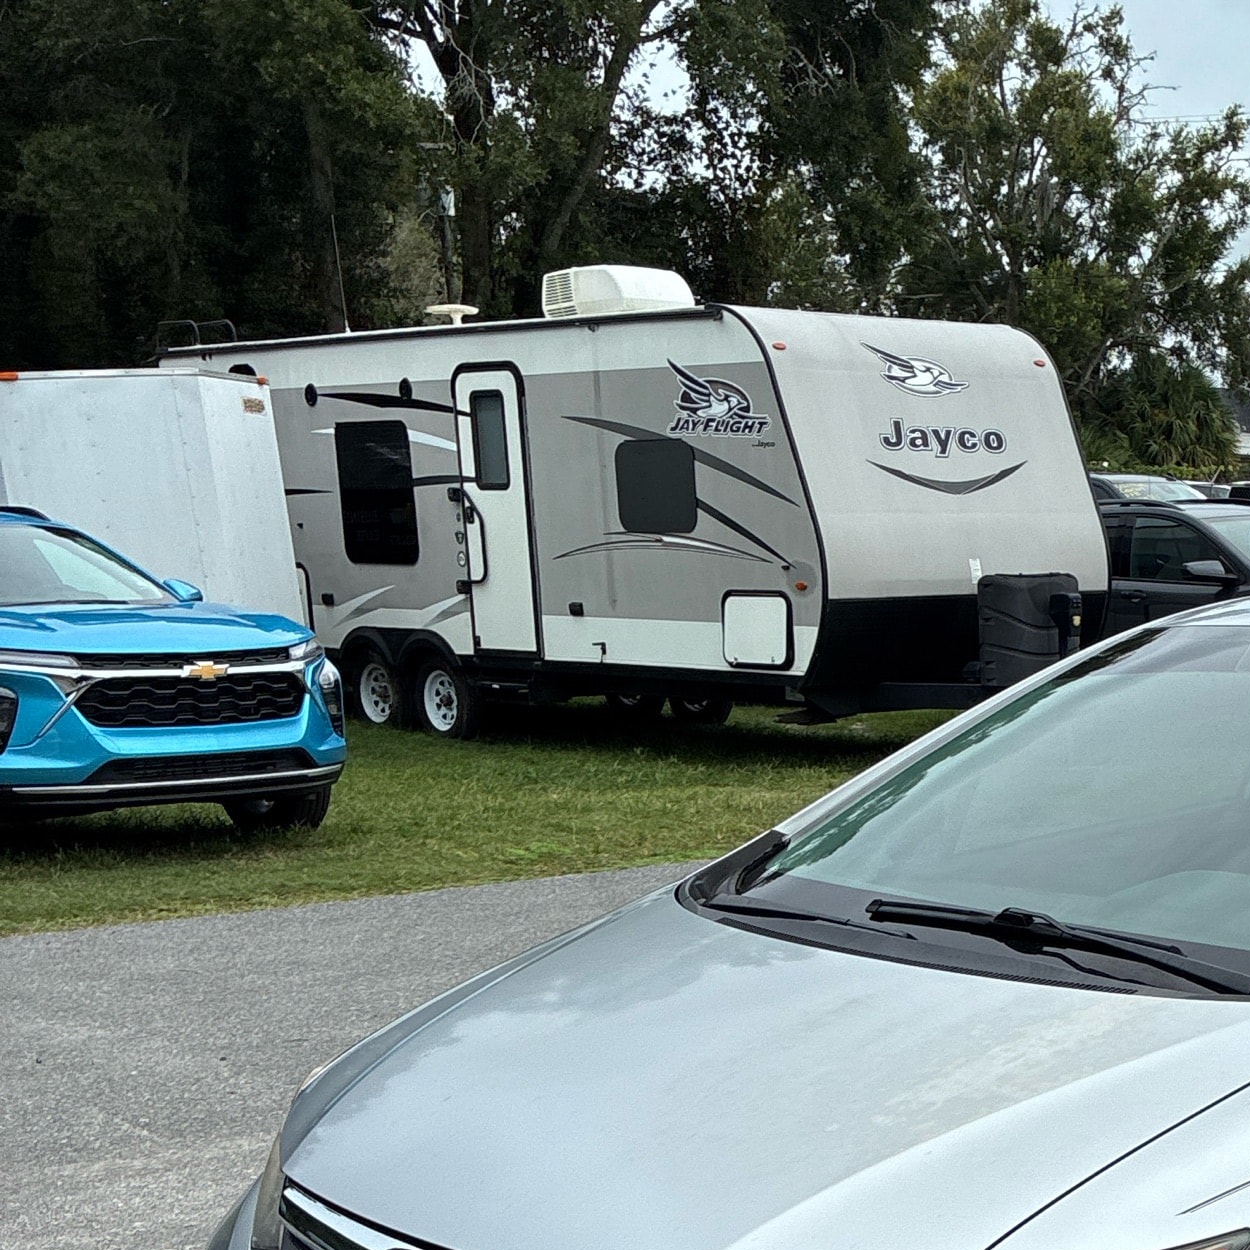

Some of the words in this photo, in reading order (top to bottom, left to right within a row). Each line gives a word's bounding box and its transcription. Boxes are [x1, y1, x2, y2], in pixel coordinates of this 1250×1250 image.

[669, 417, 702, 432] JAY
[702, 417, 769, 435] FLIGHT
[879, 418, 1007, 458] Jayco
